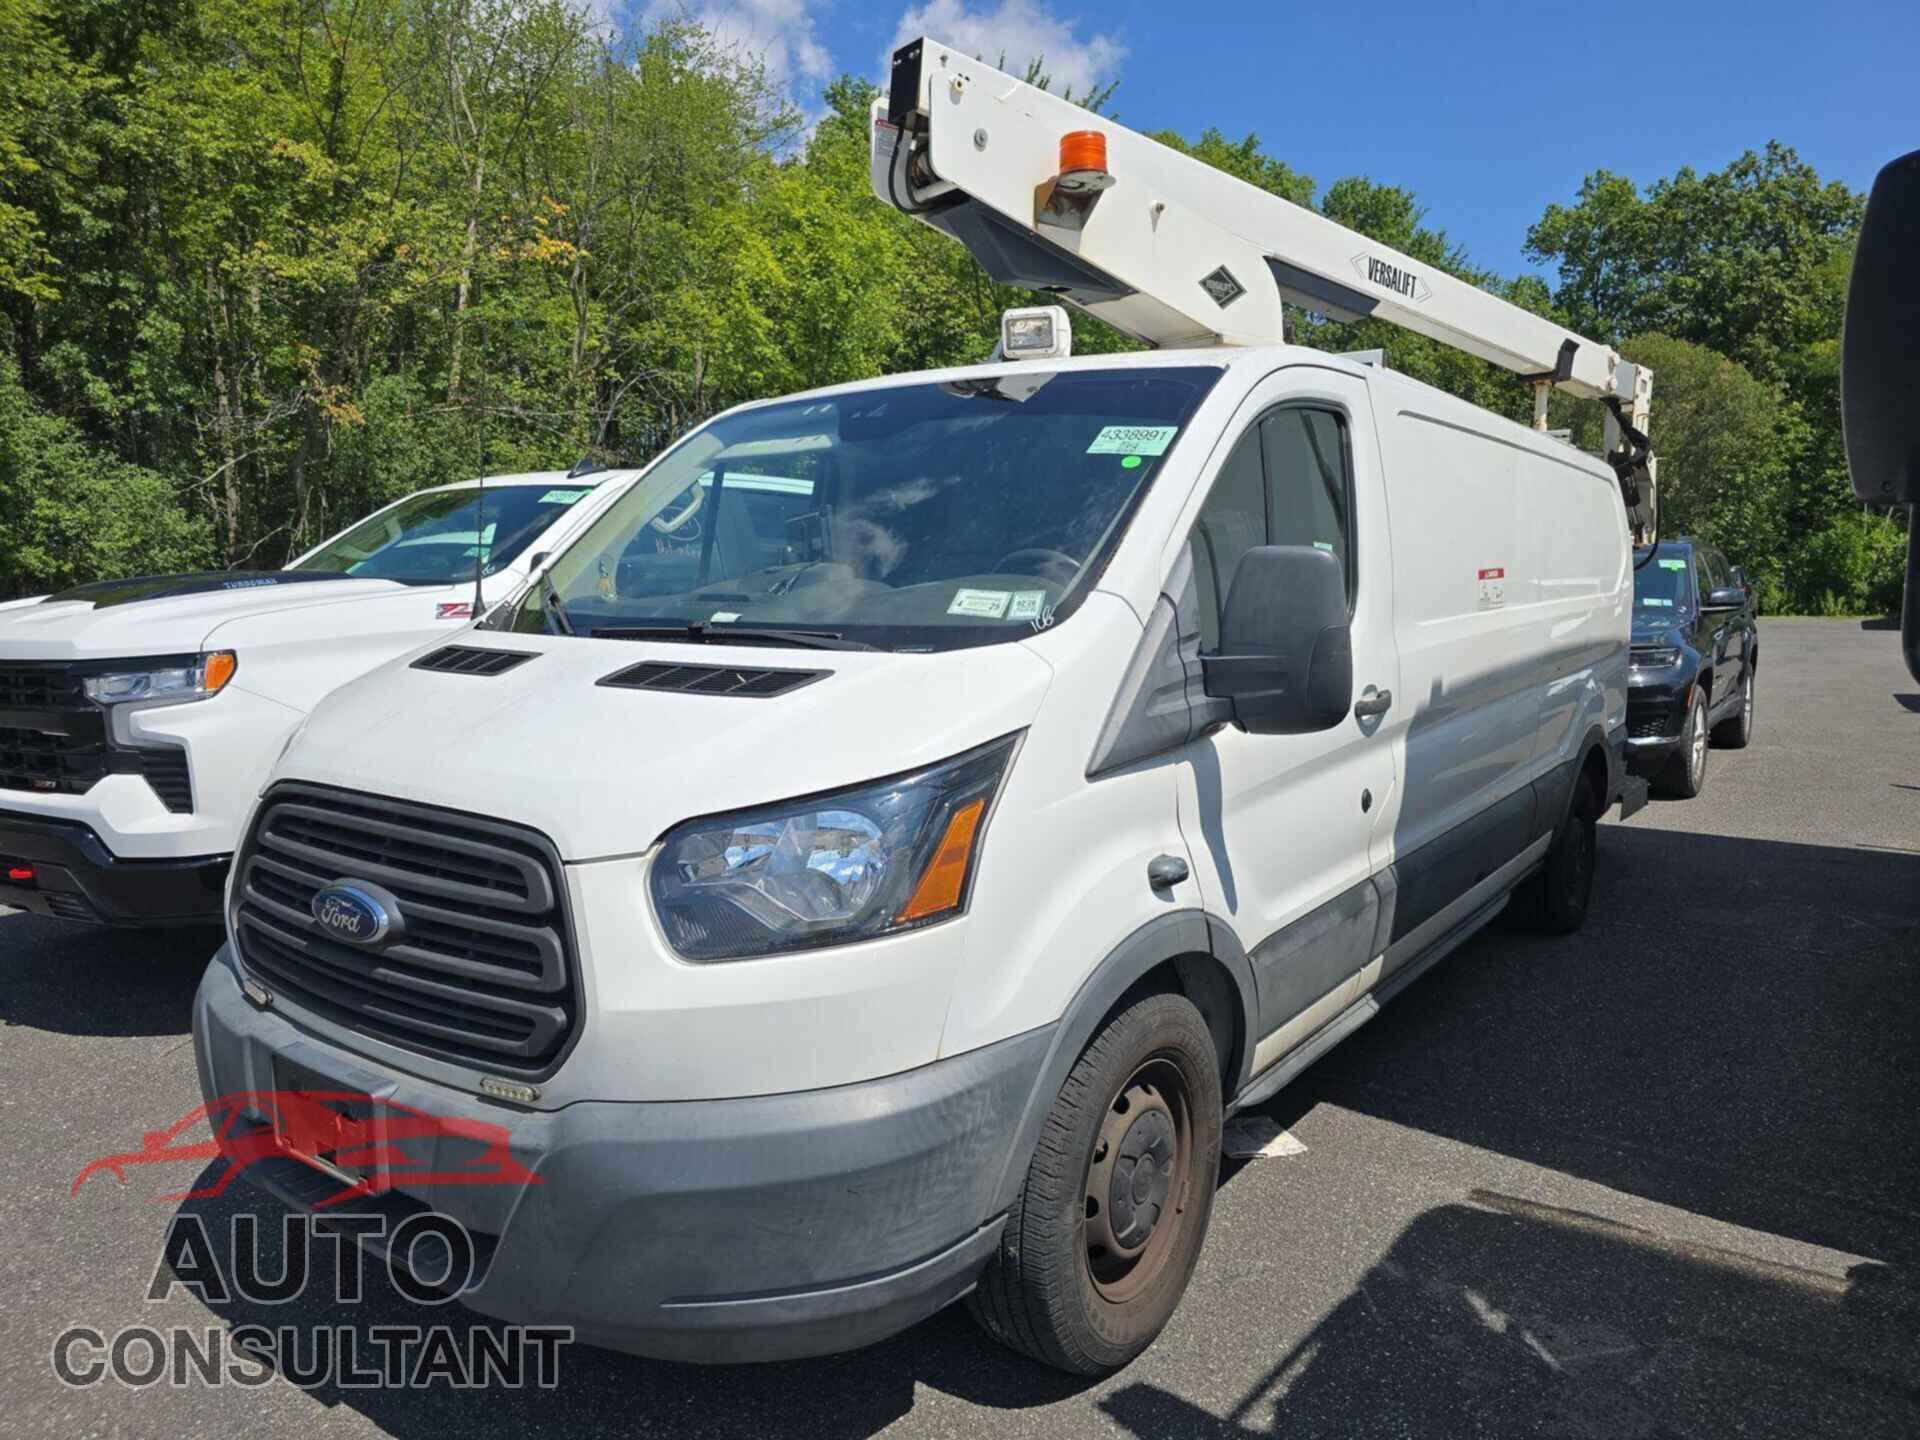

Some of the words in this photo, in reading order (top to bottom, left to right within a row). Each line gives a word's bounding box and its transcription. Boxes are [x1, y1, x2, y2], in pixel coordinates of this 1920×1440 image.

[1368, 256, 1417, 298] VERSALIFT
[1101, 428, 1168, 441] 4338991
[321, 897, 361, 933] Ford
